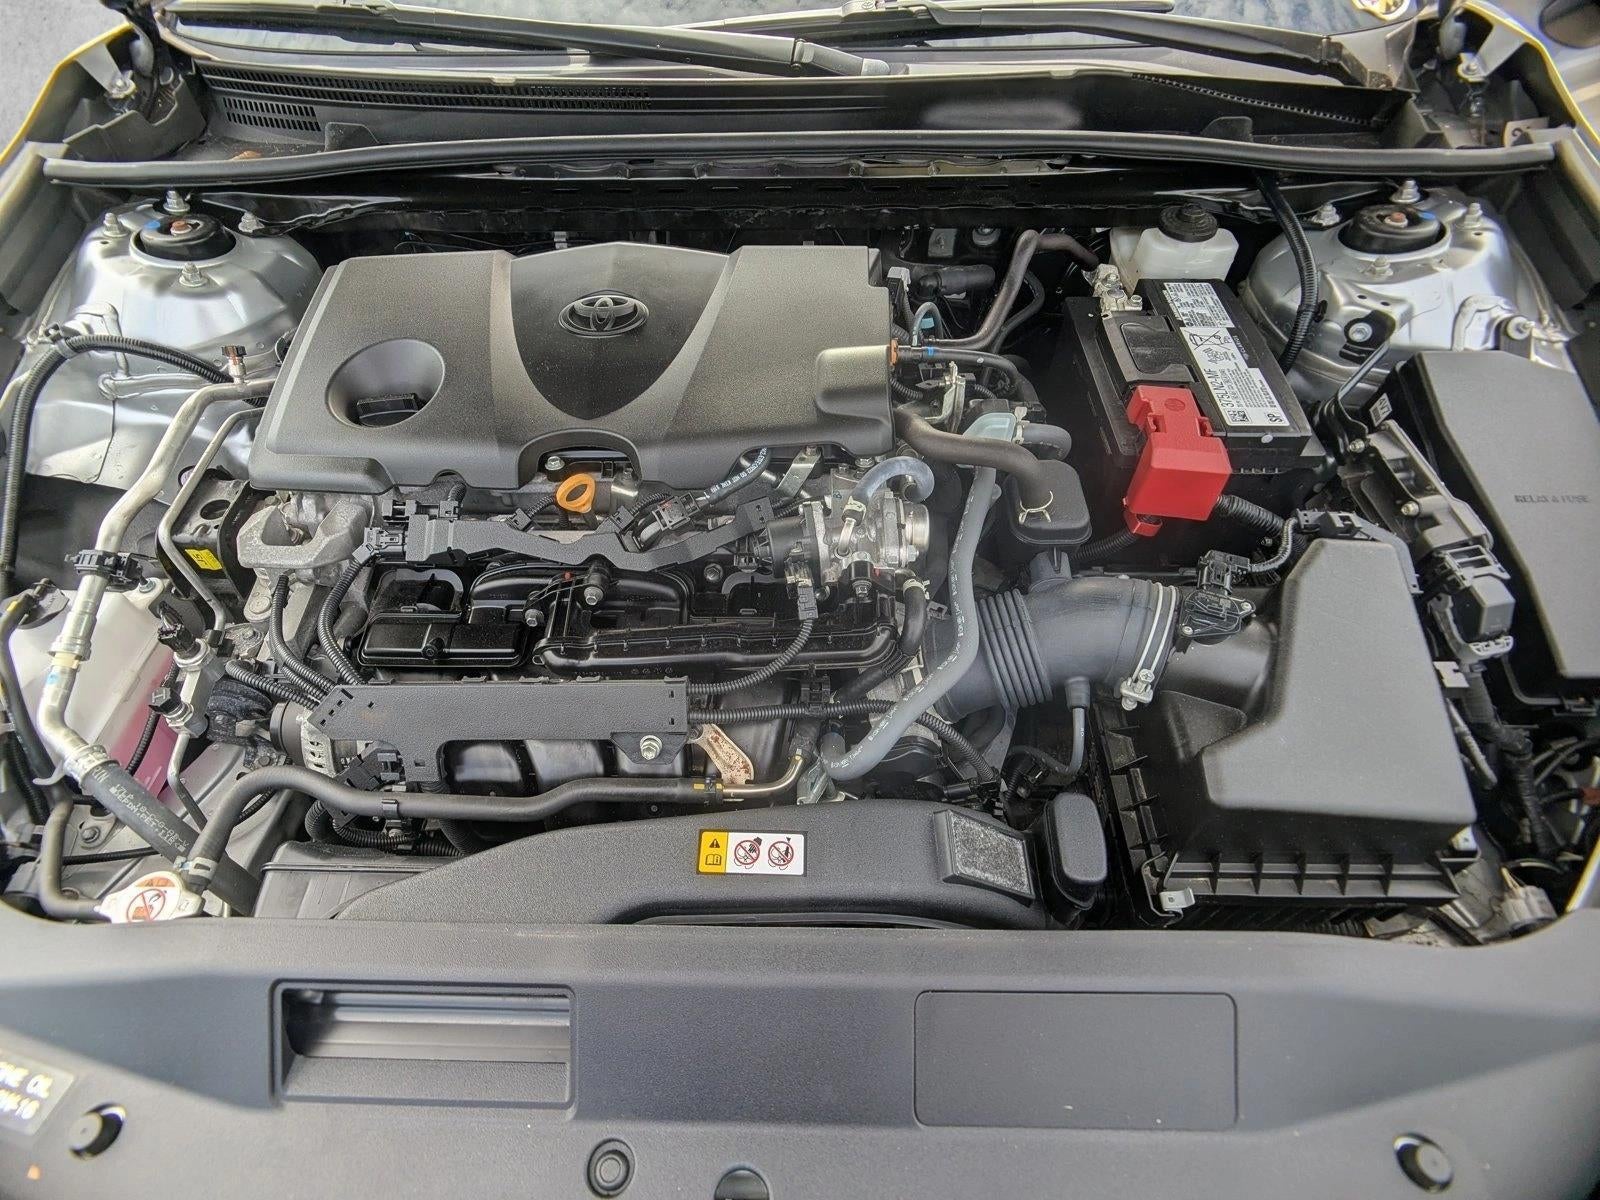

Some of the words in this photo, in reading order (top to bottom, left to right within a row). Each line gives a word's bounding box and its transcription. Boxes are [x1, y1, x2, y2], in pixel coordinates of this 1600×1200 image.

[1203, 368, 1235, 408] 375LN2-MF
[1267, 413, 1283, 423] SP
[1514, 494, 1549, 504] RELAY
